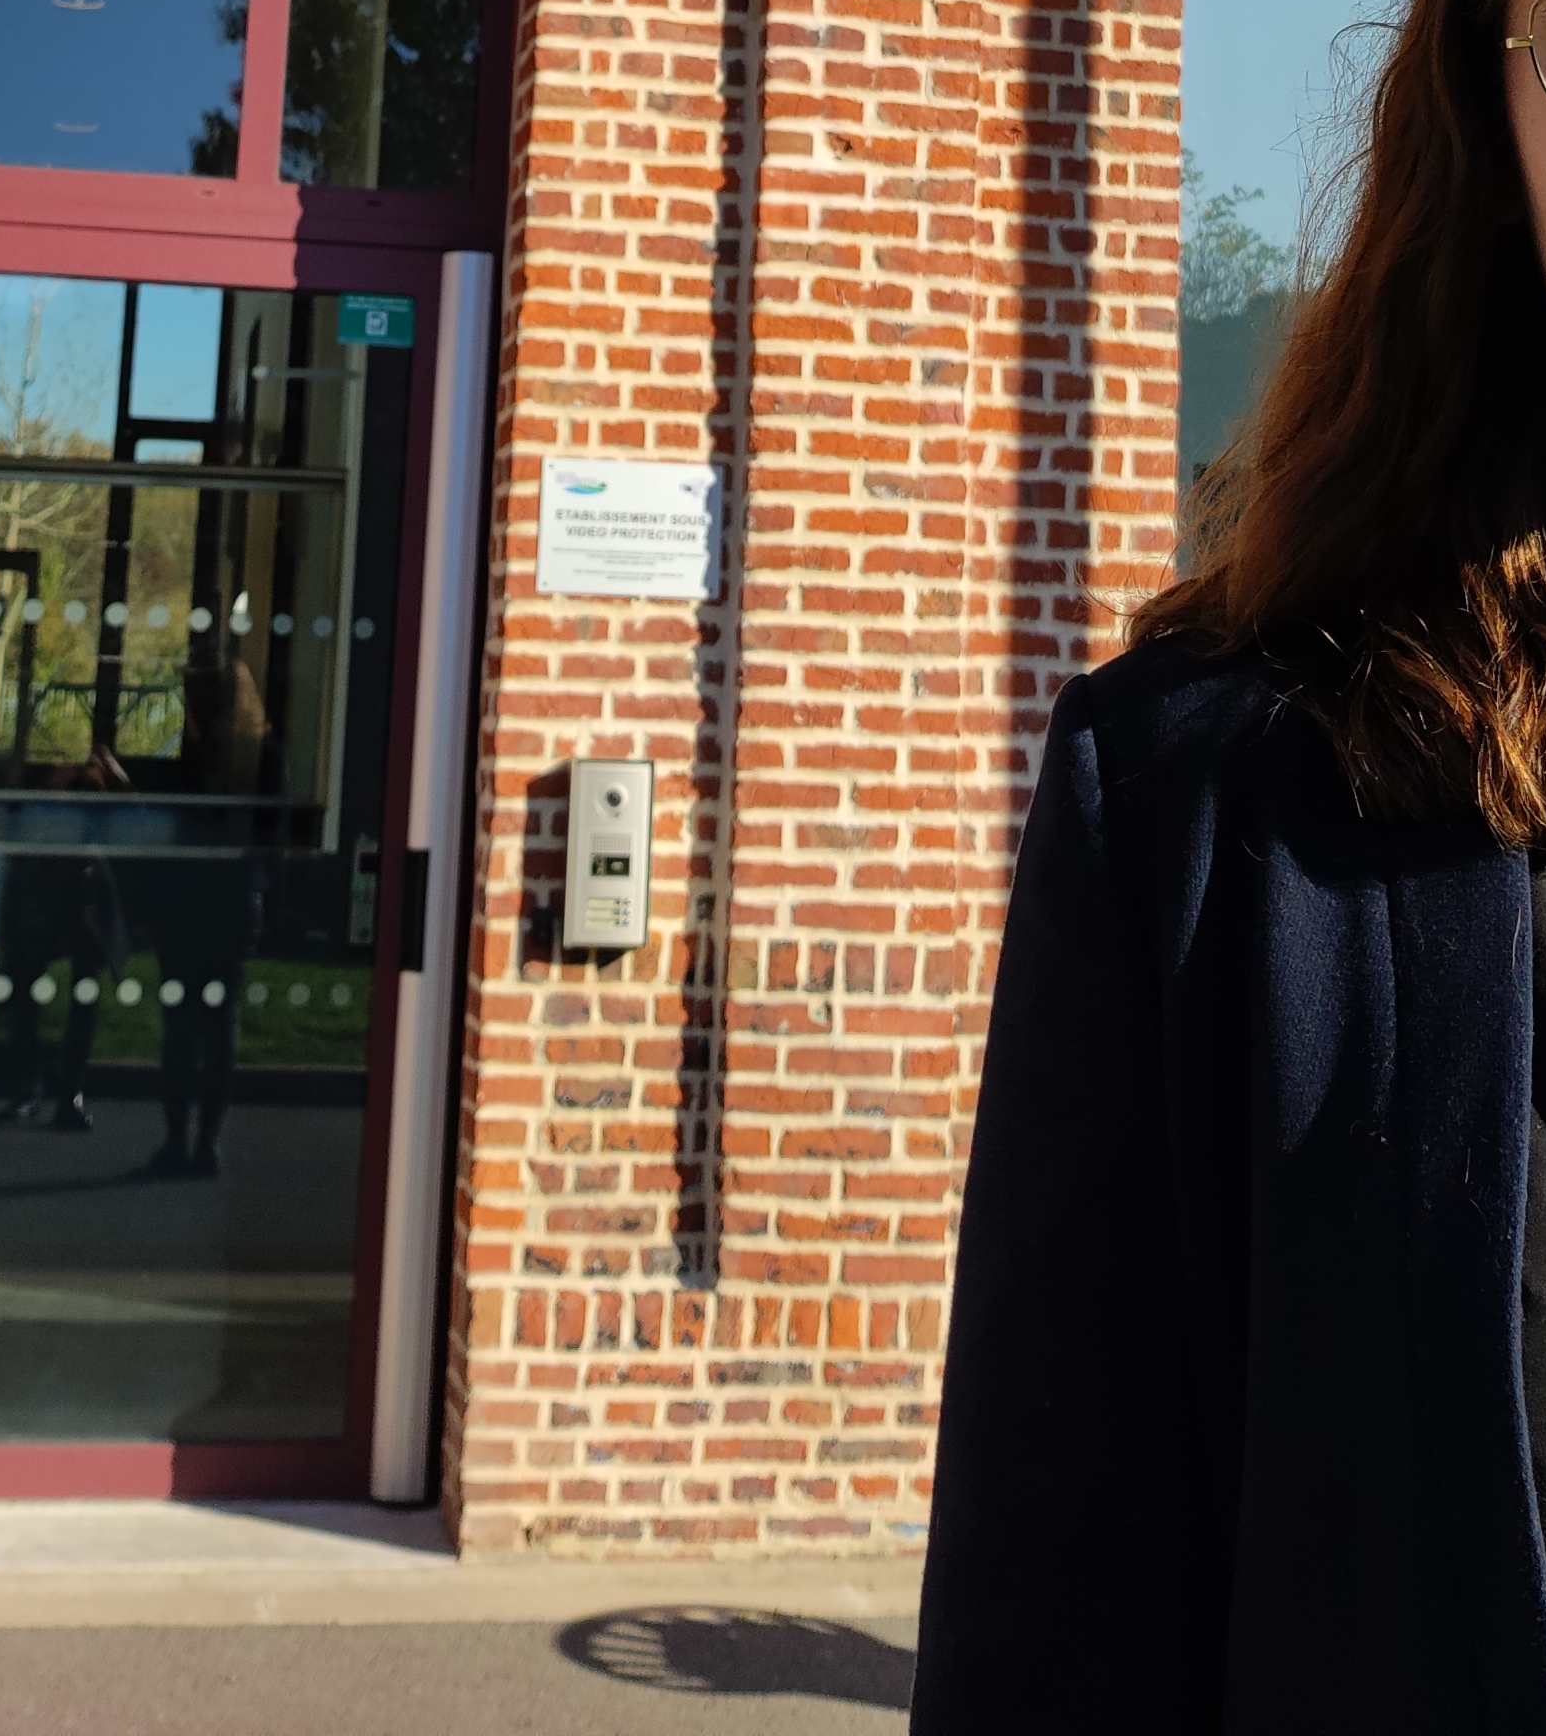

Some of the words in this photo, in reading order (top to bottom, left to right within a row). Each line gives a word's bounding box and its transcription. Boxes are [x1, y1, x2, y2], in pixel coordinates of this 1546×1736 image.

[555, 509, 667, 524] ETABLISSEMENT
[670, 514, 706, 526] SOUS
[566, 526, 606, 537] VIDEO
[610, 528, 697, 541] PROTECTION
